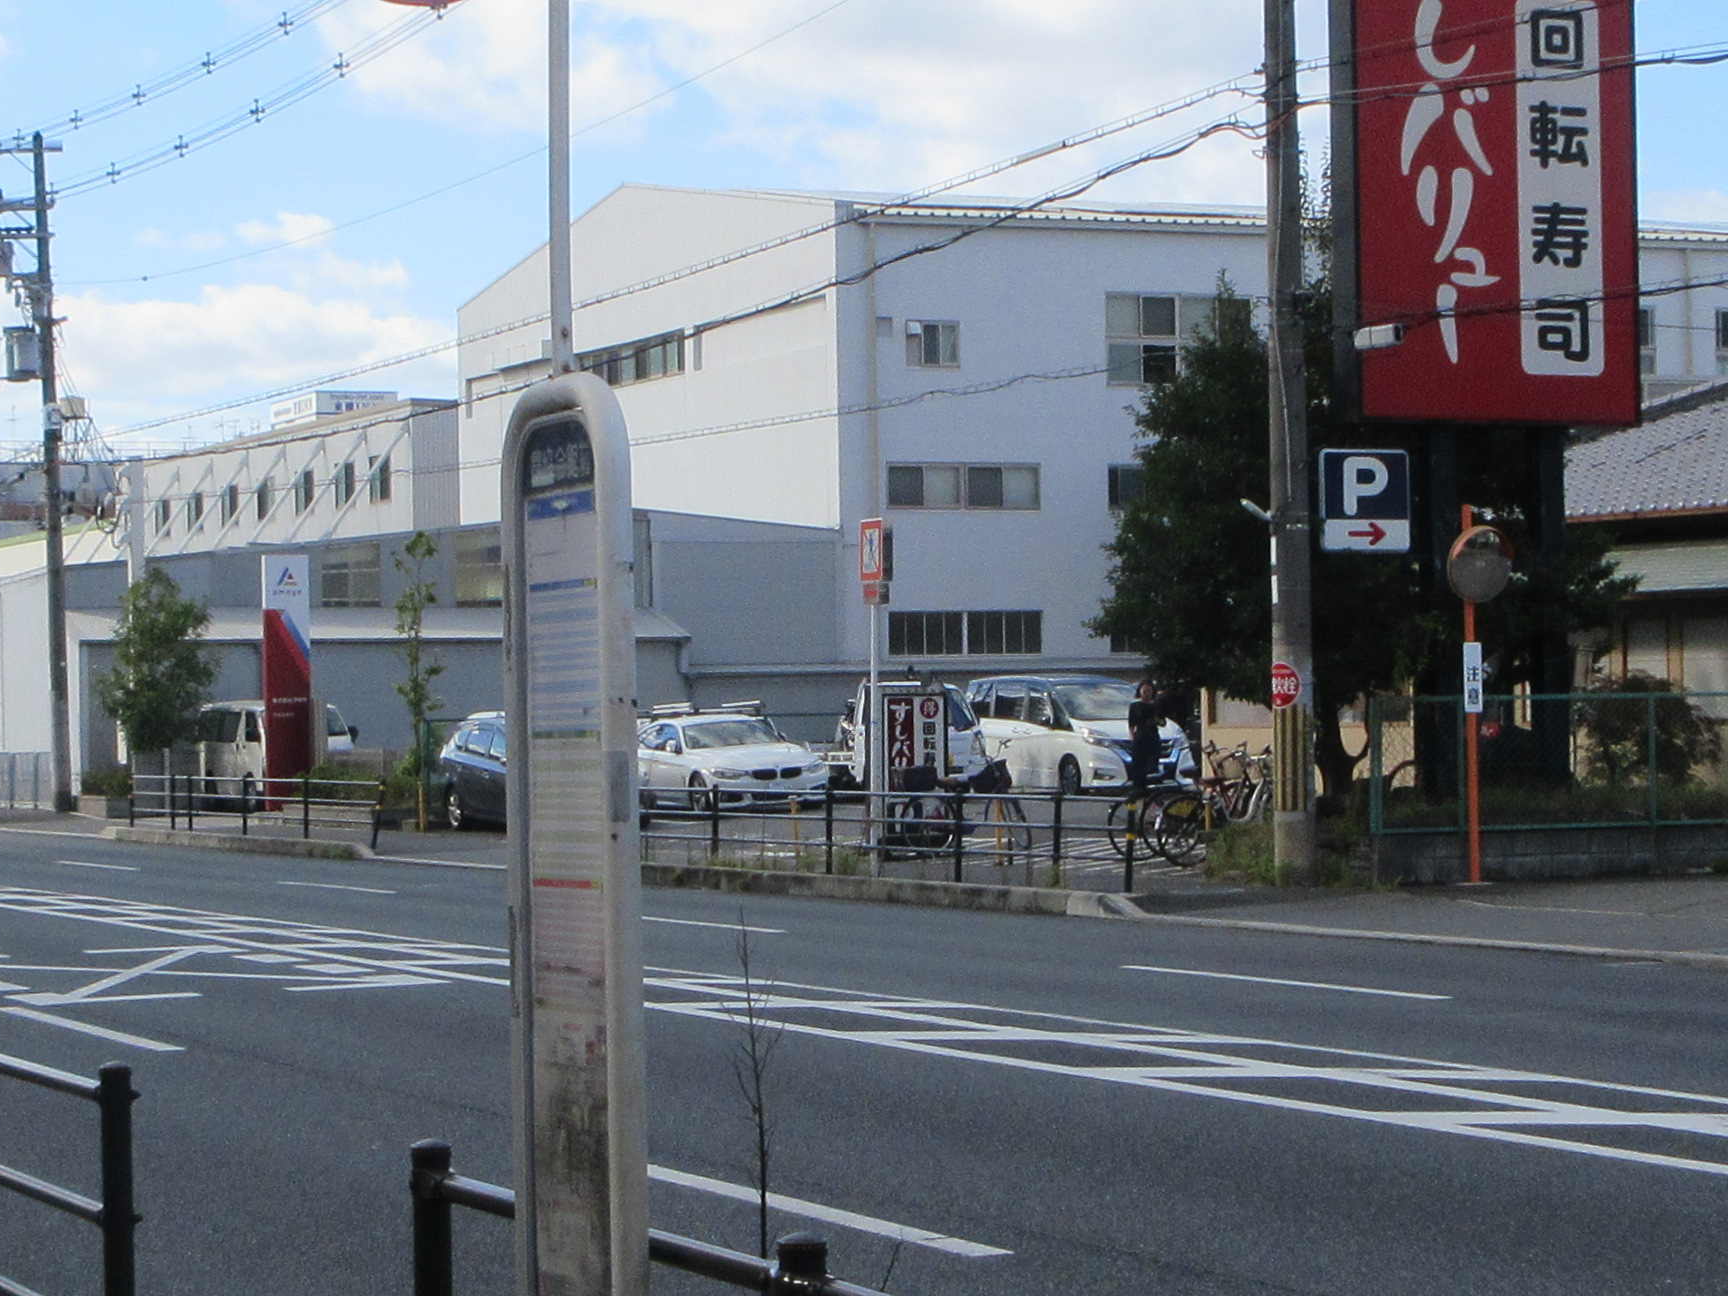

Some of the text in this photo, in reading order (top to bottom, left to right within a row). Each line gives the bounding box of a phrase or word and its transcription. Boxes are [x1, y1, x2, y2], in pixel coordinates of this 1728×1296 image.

[1528, 8, 1591, 362] 回転寿司
[1342, 456, 1389, 516] P
[1272, 676, 1297, 694] 火栓
